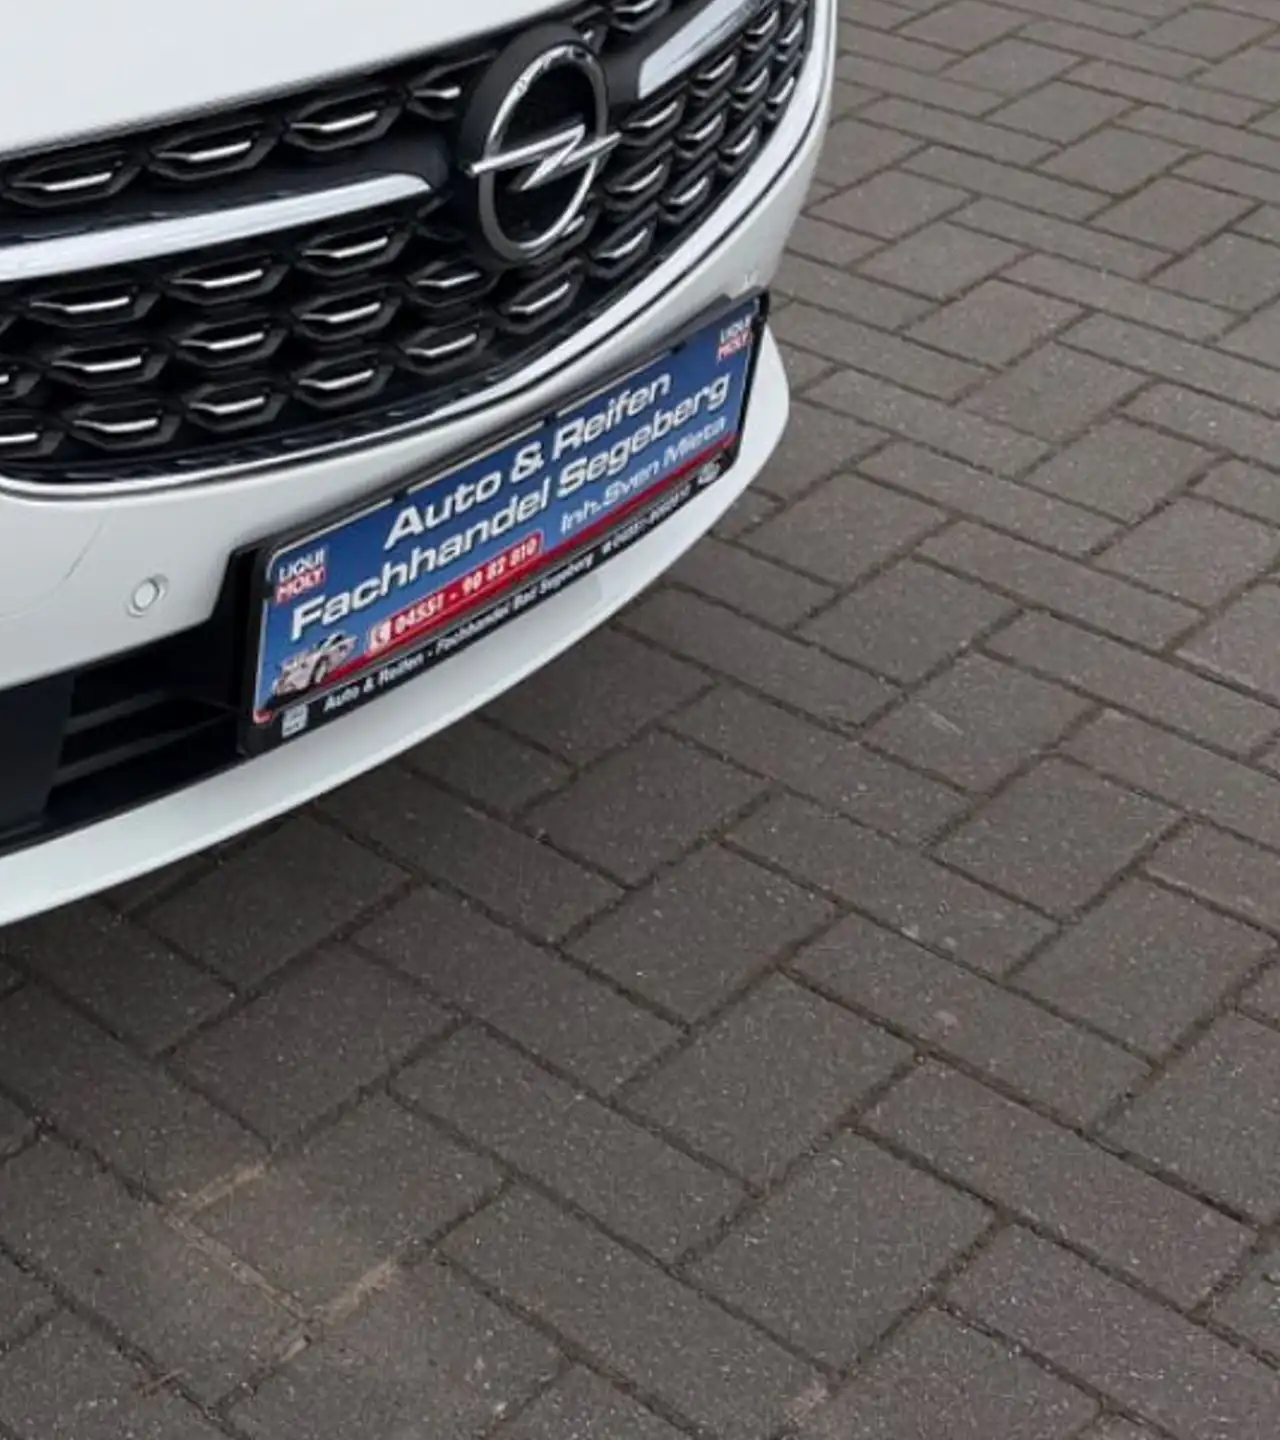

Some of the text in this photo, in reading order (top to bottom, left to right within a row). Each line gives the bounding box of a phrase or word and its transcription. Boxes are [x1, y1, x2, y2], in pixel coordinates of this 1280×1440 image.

[291, 475, 551, 642] Fachhandel
[556, 372, 731, 499] Segeberg
[383, 373, 672, 550] Auto & Reifen
